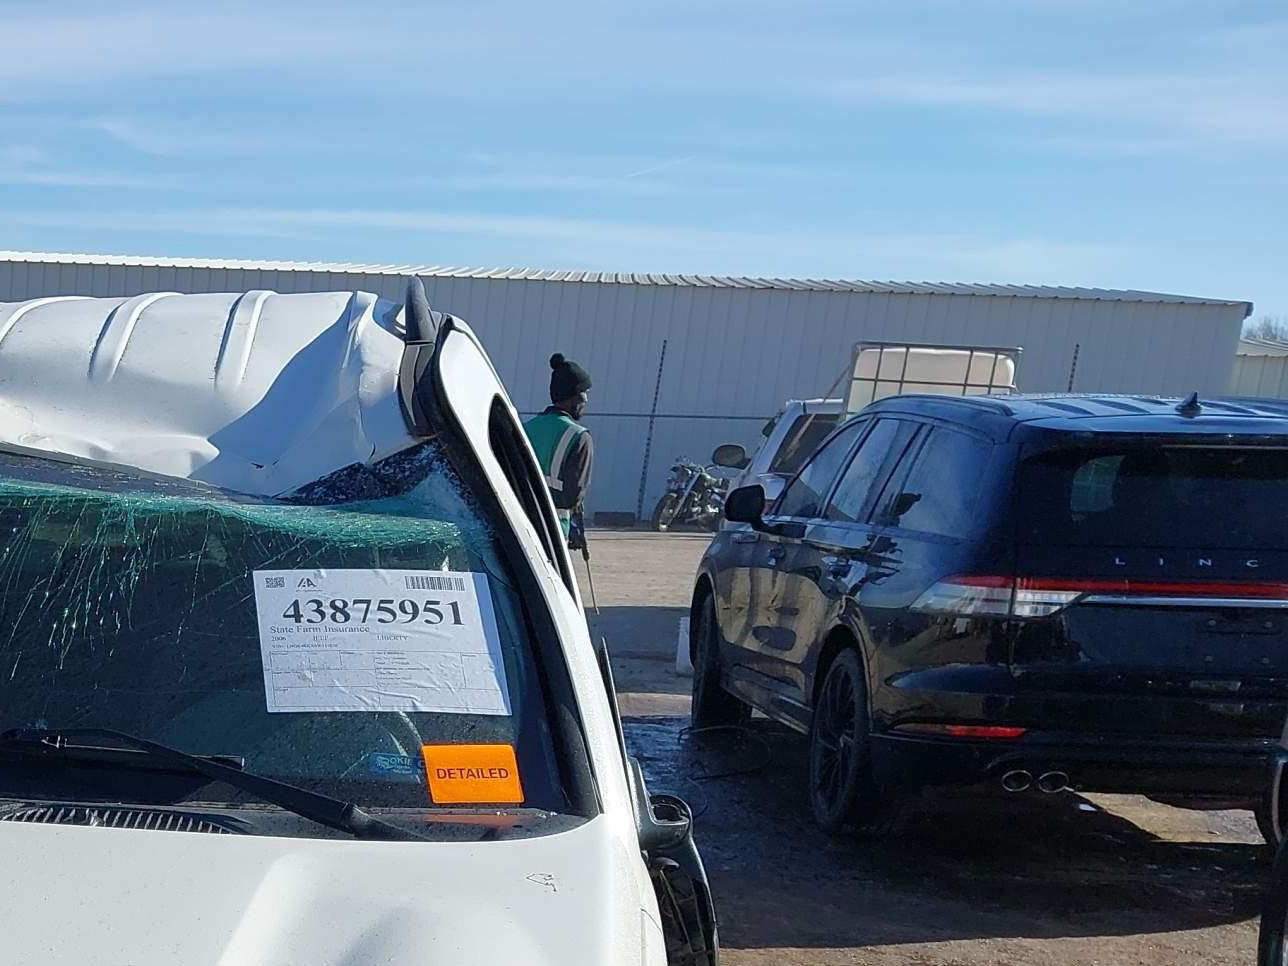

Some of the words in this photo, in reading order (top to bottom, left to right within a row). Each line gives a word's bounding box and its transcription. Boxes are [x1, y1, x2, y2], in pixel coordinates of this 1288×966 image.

[282, 598, 465, 626] 43875951
[270, 624, 294, 634] State
[296, 624, 321, 633] Farm
[324, 624, 370, 634] Insurance
[436, 767, 509, 780] DETAILED
